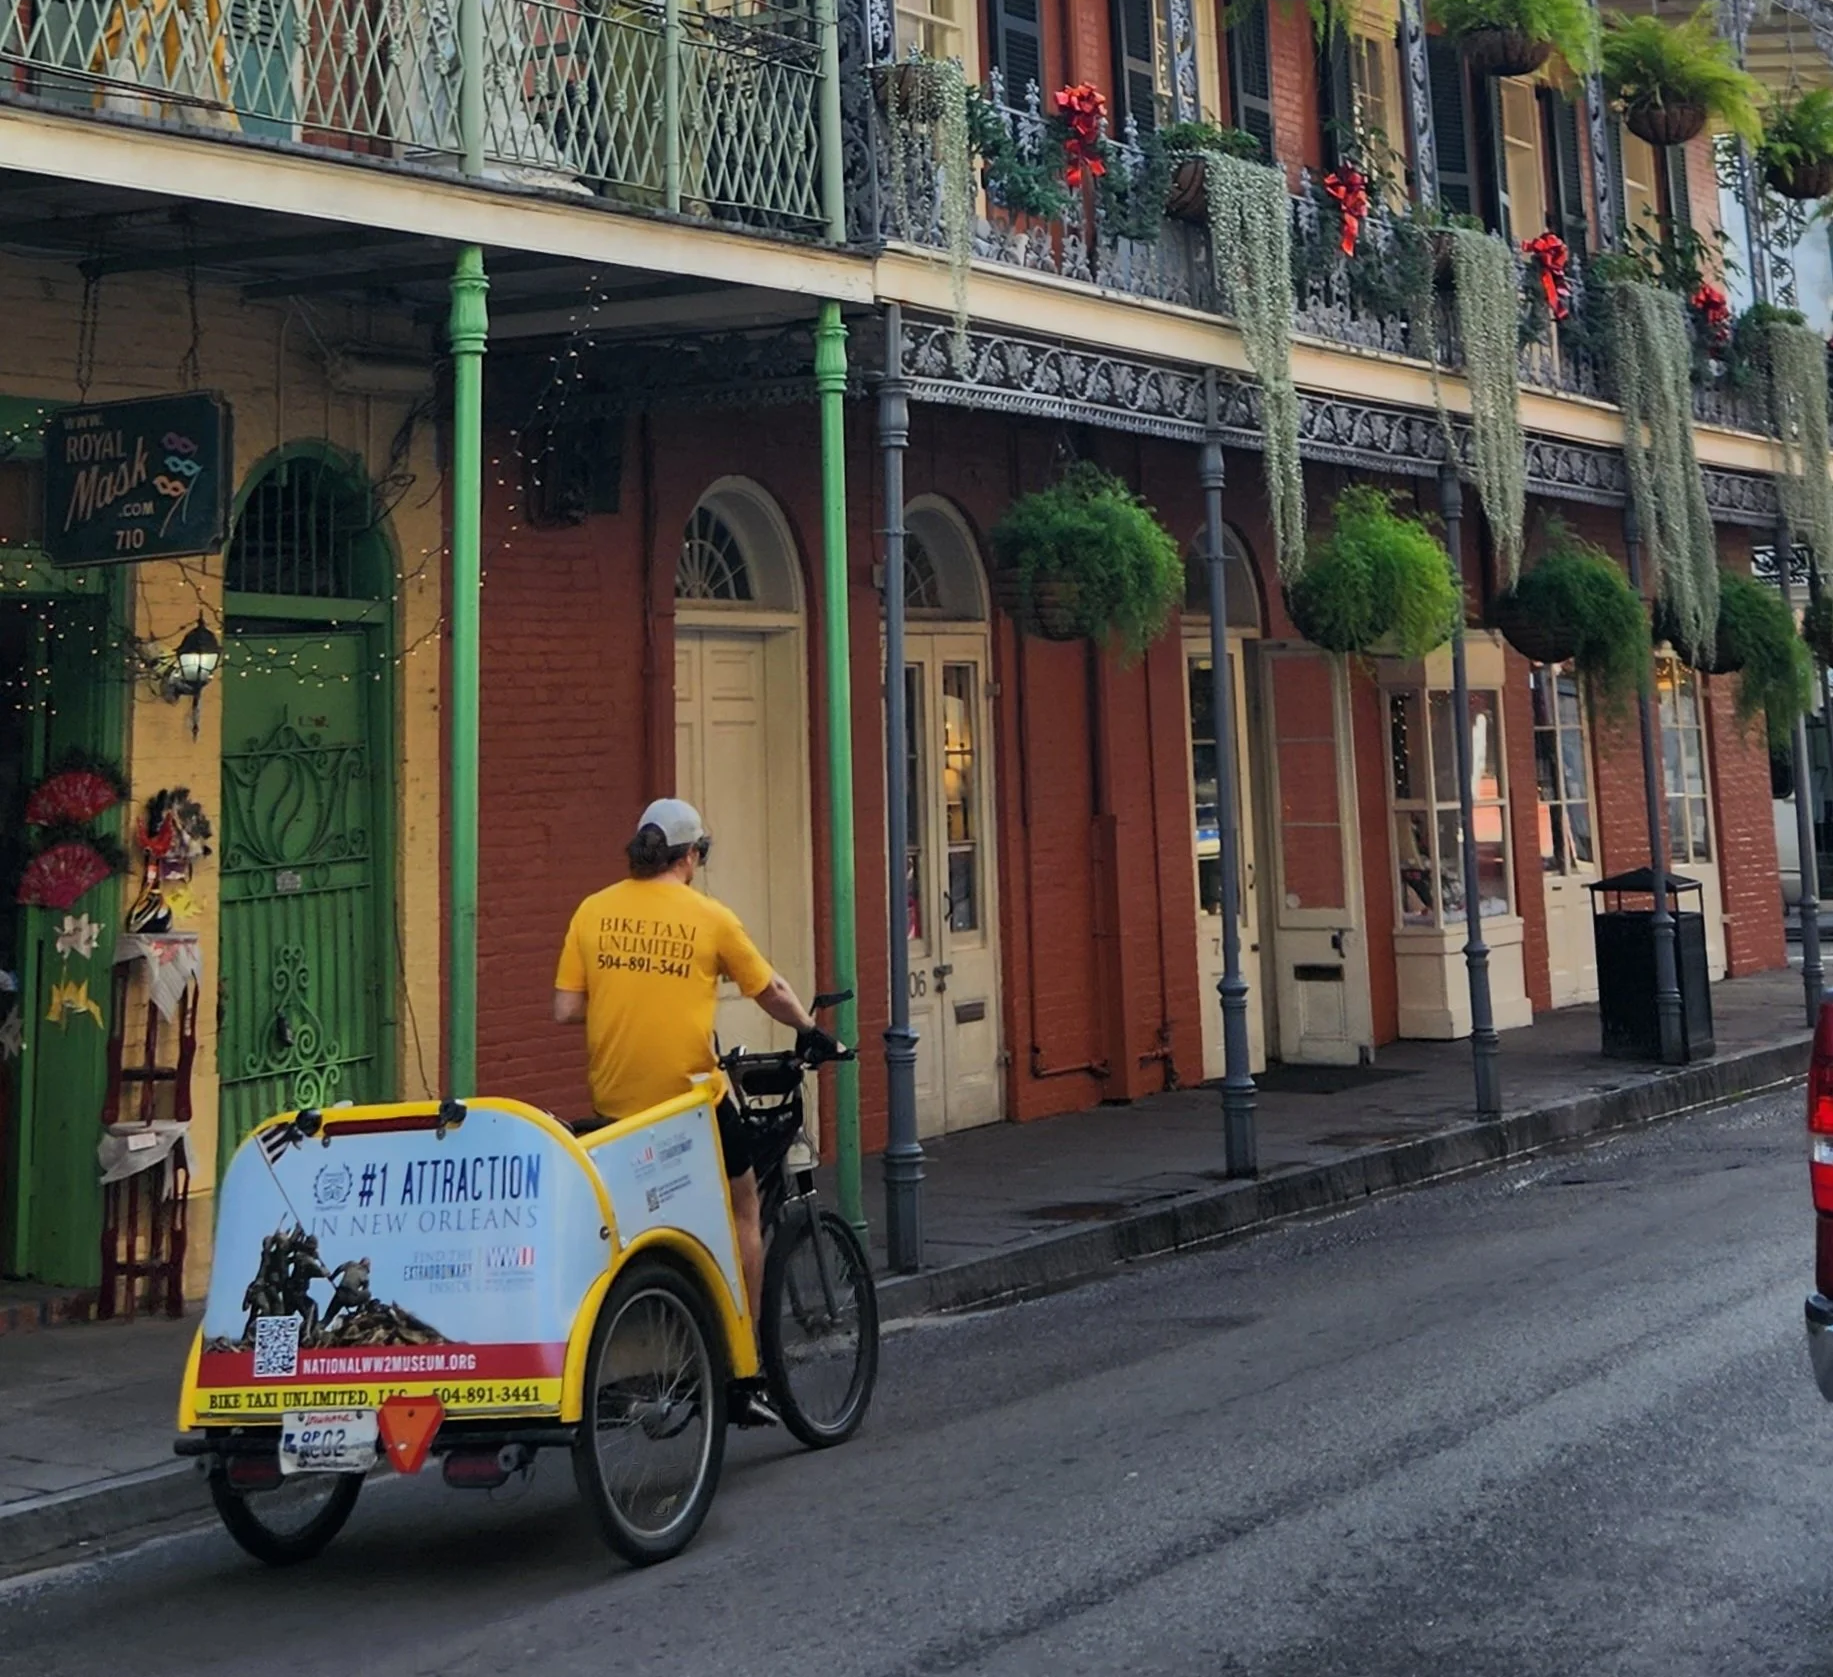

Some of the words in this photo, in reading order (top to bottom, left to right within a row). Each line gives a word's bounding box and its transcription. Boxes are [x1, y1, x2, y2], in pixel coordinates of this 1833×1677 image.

[66, 430, 127, 463] ROYAL
[64, 436, 149, 532] Mask
[116, 528, 144, 550] 710
[600, 917, 647, 934] BIKE
[653, 921, 698, 942] TAXI
[599, 935, 694, 961] UNLIMITED
[597, 954, 691, 979] 504-891-3441
[358, 1162, 388, 1208] #1
[400, 1154, 541, 1206] ATTRACTION
[310, 1216, 338, 1238] IN
[349, 1212, 408, 1237] NEW
[418, 1205, 539, 1233] ORLEANS
[303, 1354, 477, 1374] NATIONALWW2MUSEUM.ORG
[209, 1393, 242, 1409] BIKE
[246, 1393, 278, 1408] TAXI
[283, 1390, 373, 1408] UNLIMITED,
[432, 1386, 540, 1404] 504-891-3441
